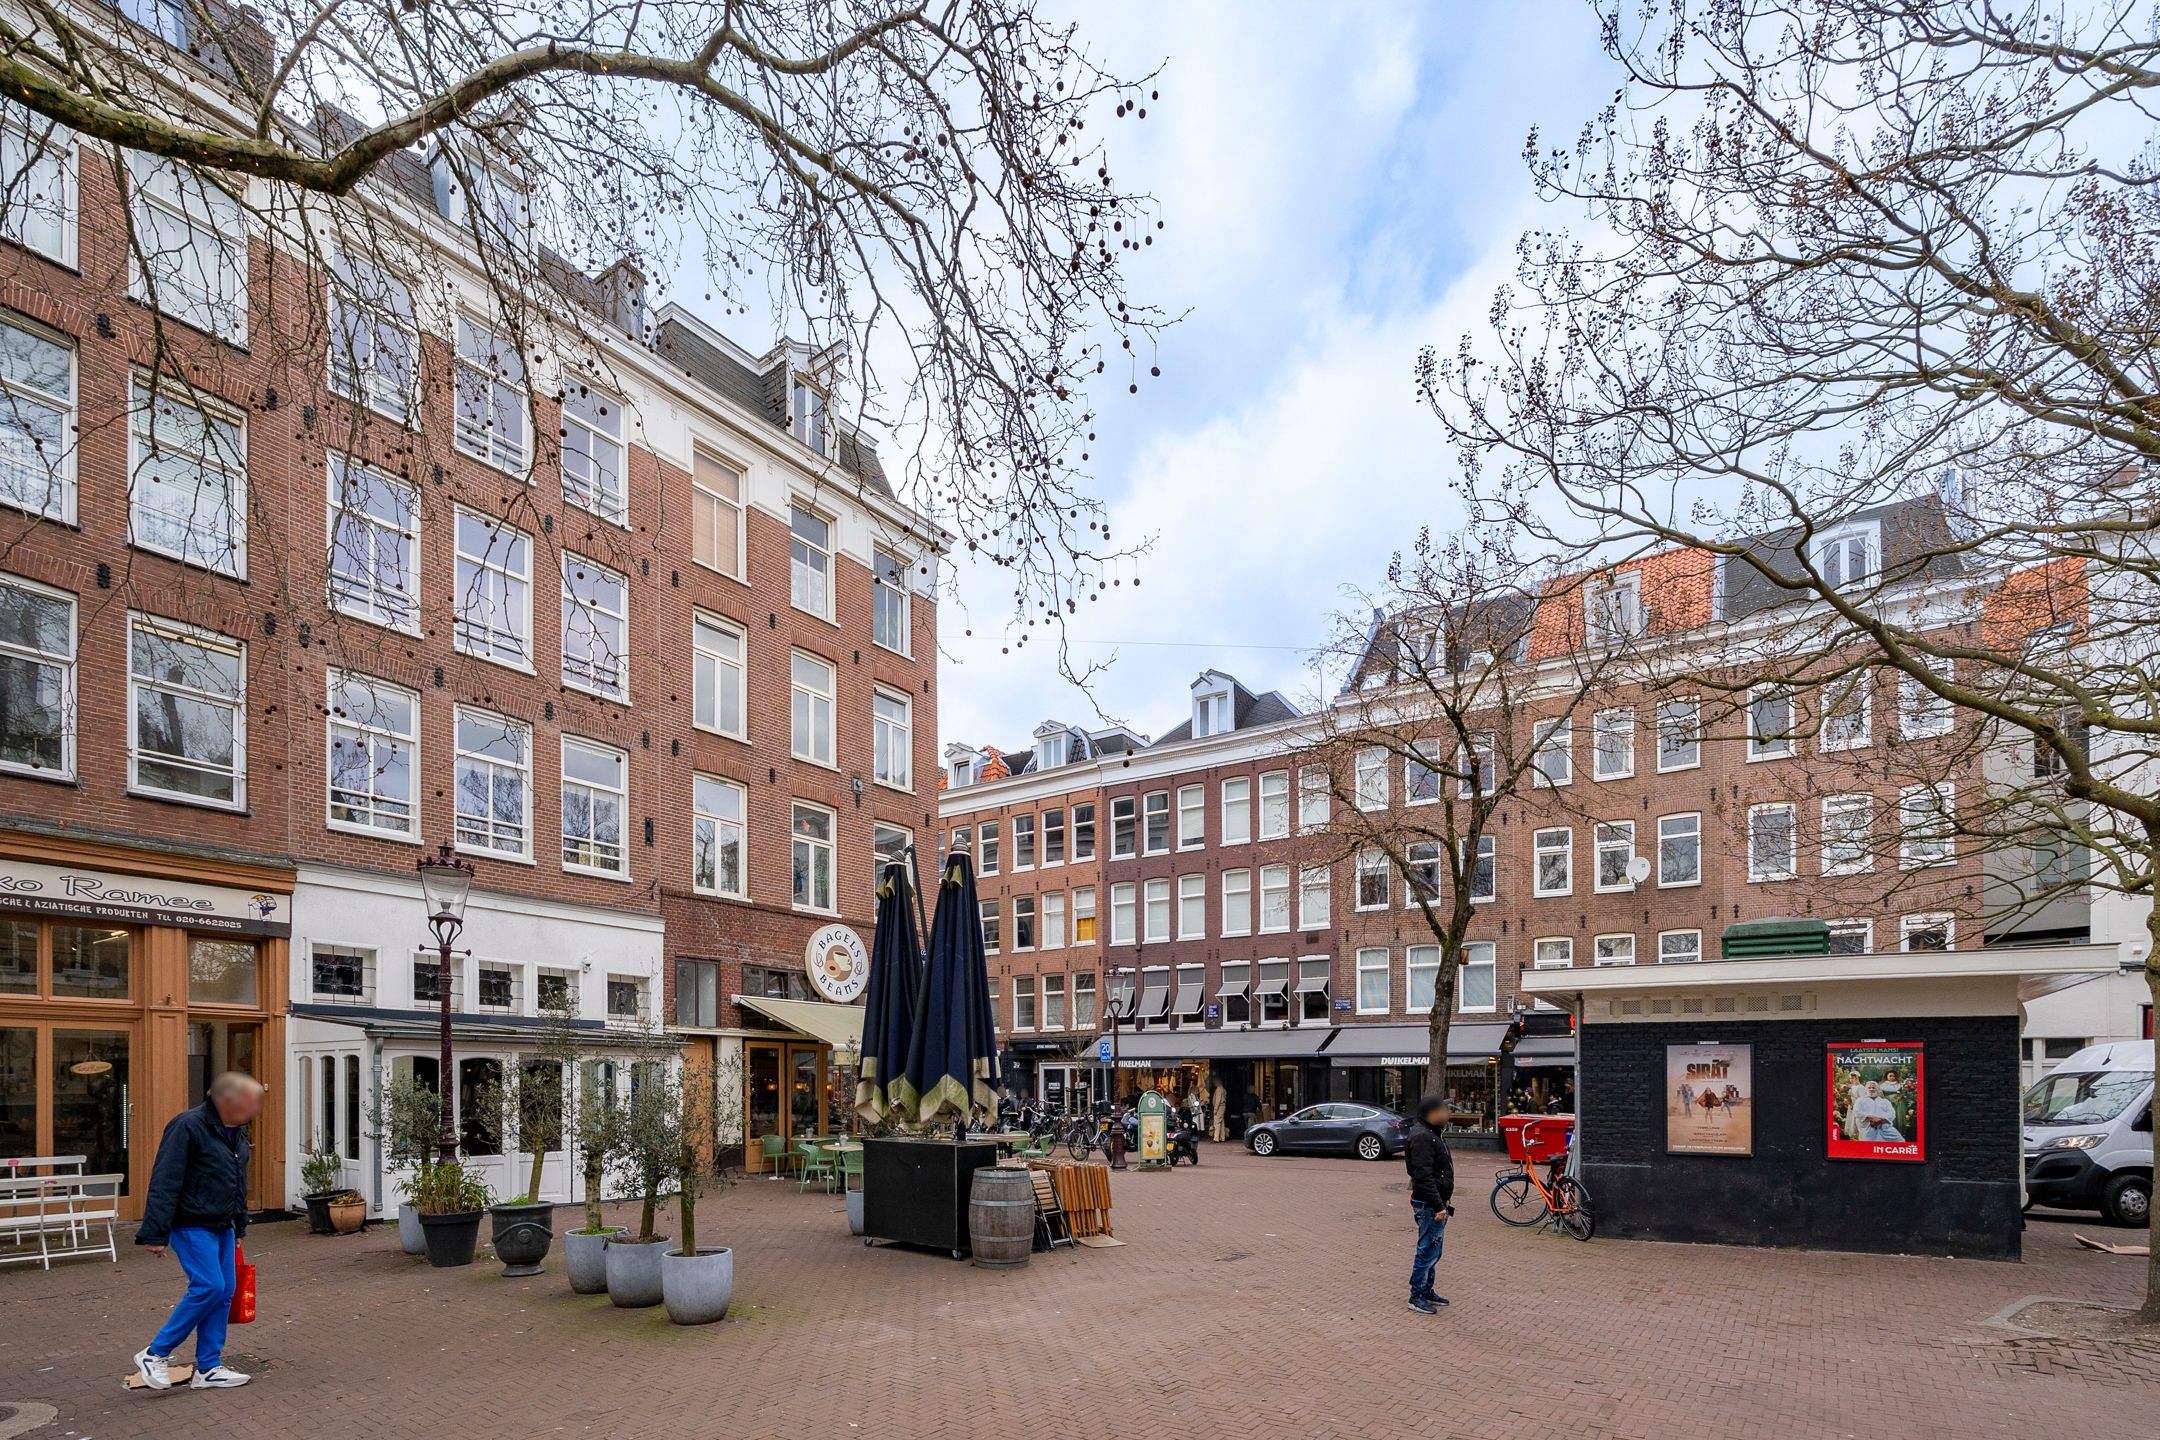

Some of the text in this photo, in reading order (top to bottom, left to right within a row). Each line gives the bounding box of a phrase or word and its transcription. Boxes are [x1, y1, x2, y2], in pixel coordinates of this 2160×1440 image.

[60, 875, 215, 912] Ramee
[34, 900, 92, 914] AZIATISCHE
[96, 904, 149, 919] PRODUKTEN
[157, 913, 172, 922] TEL
[176, 915, 242, 929] 020-6622025
[818, 930, 862, 958] BAGELS
[820, 974, 859, 996] BEANS
[1101, 1043, 1110, 1054] 20
[1836, 1056, 1913, 1064] NACHTWACHT
